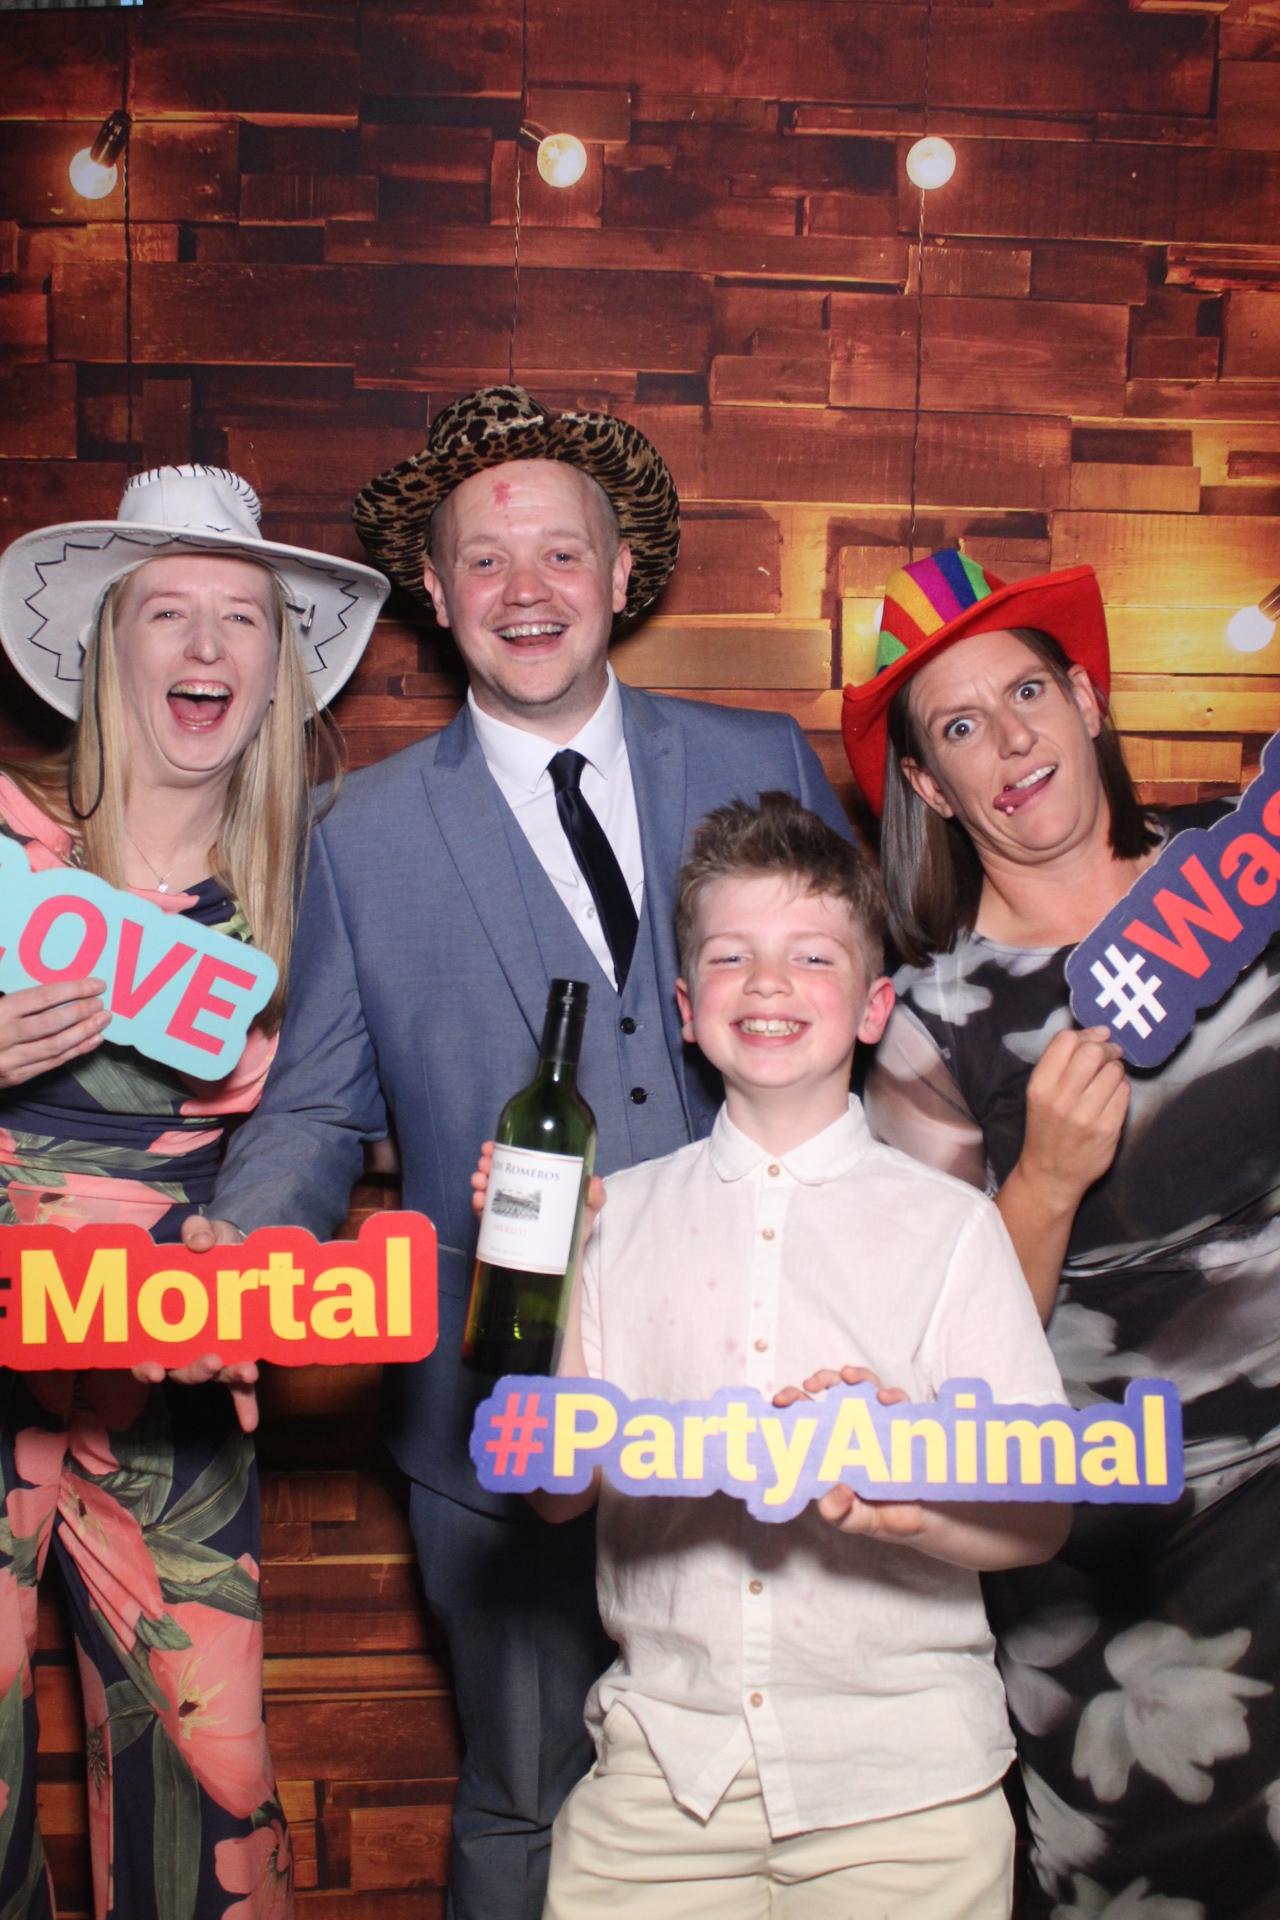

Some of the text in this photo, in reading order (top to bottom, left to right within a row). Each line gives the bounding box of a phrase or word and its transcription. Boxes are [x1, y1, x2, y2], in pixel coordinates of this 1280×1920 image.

[0, 893, 257, 1057] OVE
[504, 1161, 561, 1182] ROMEROS
[0, 1236, 412, 1344] Mortal
[486, 1393, 1169, 1505] #PartyAnimal
